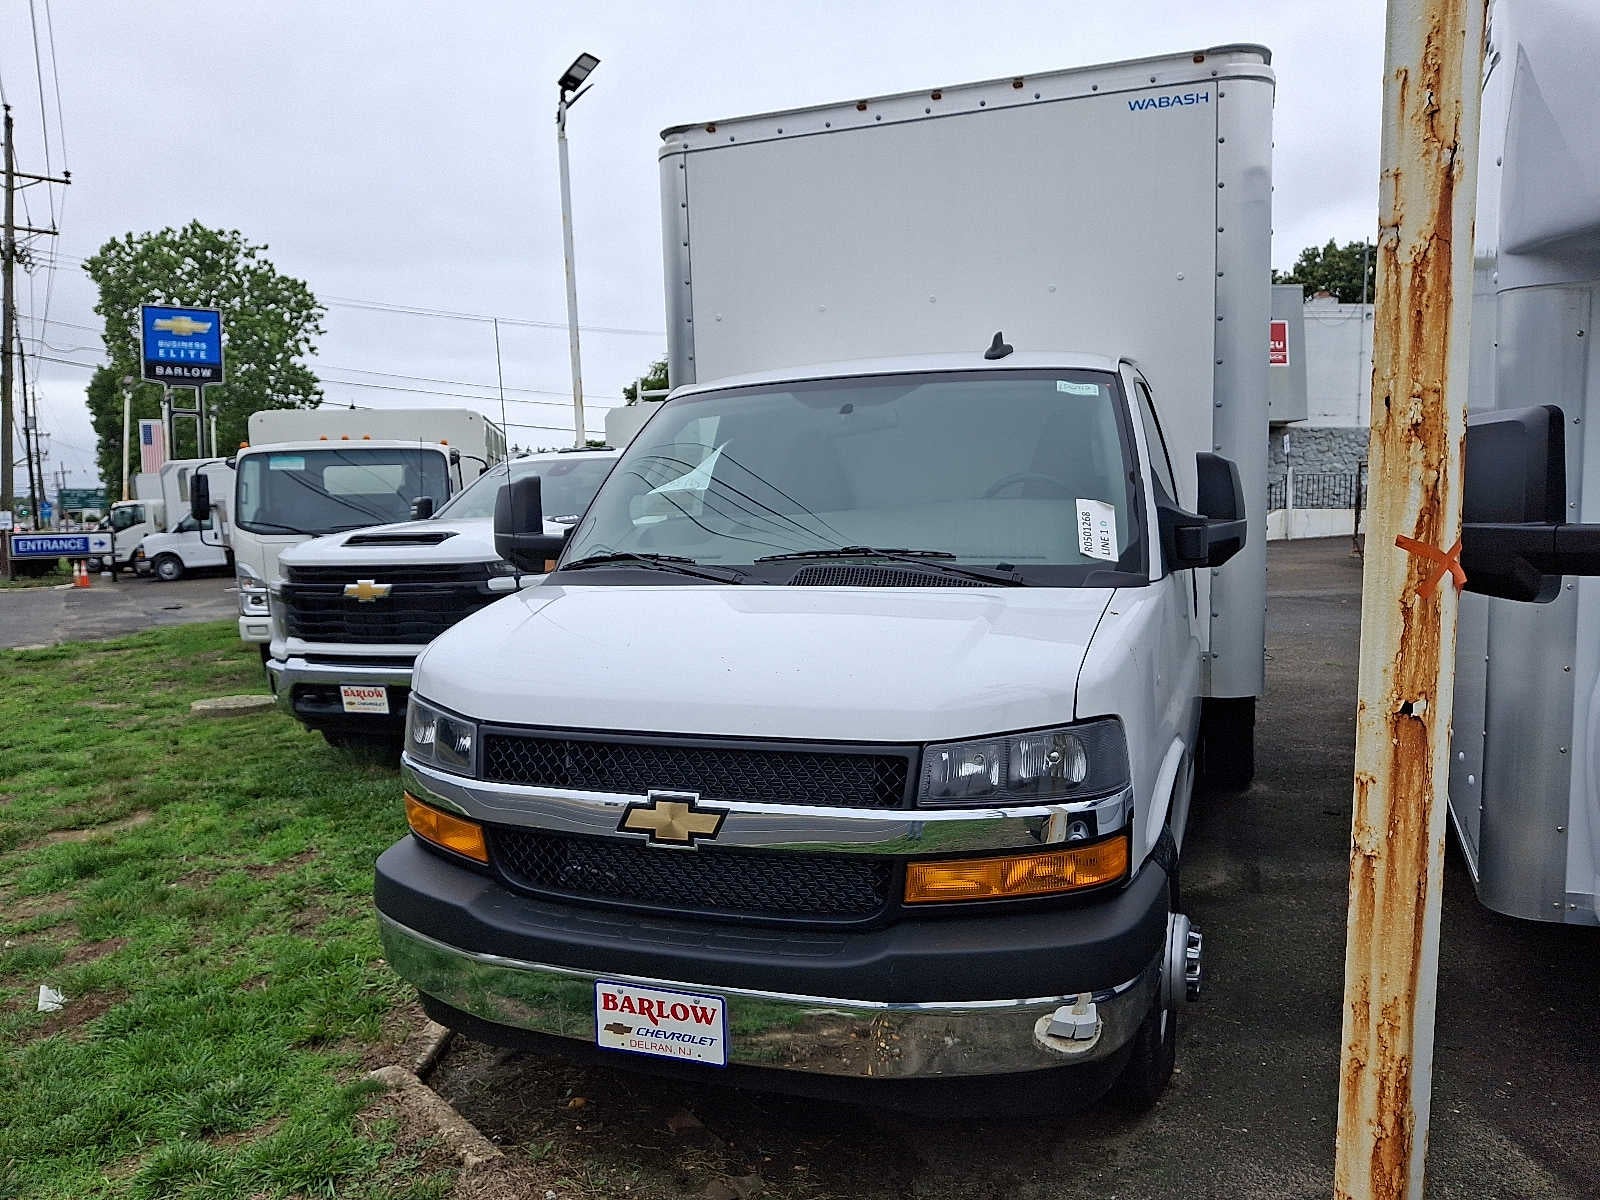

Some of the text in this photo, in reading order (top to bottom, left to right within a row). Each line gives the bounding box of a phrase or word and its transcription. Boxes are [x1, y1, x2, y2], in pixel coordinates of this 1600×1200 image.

[1128, 92, 1209, 111] WABASH
[158, 340, 207, 349] BUSINESS
[159, 349, 207, 359] ELITE
[155, 365, 212, 378] BARLOW
[18, 538, 86, 551] ENTRANCE
[1101, 537, 1110, 556] LINE
[343, 689, 383, 700] BARLOW
[602, 993, 717, 1026] BARLOW
[636, 1027, 718, 1046] CHEVROLET
[629, 1039, 692, 1056] DELRAN, NJ
